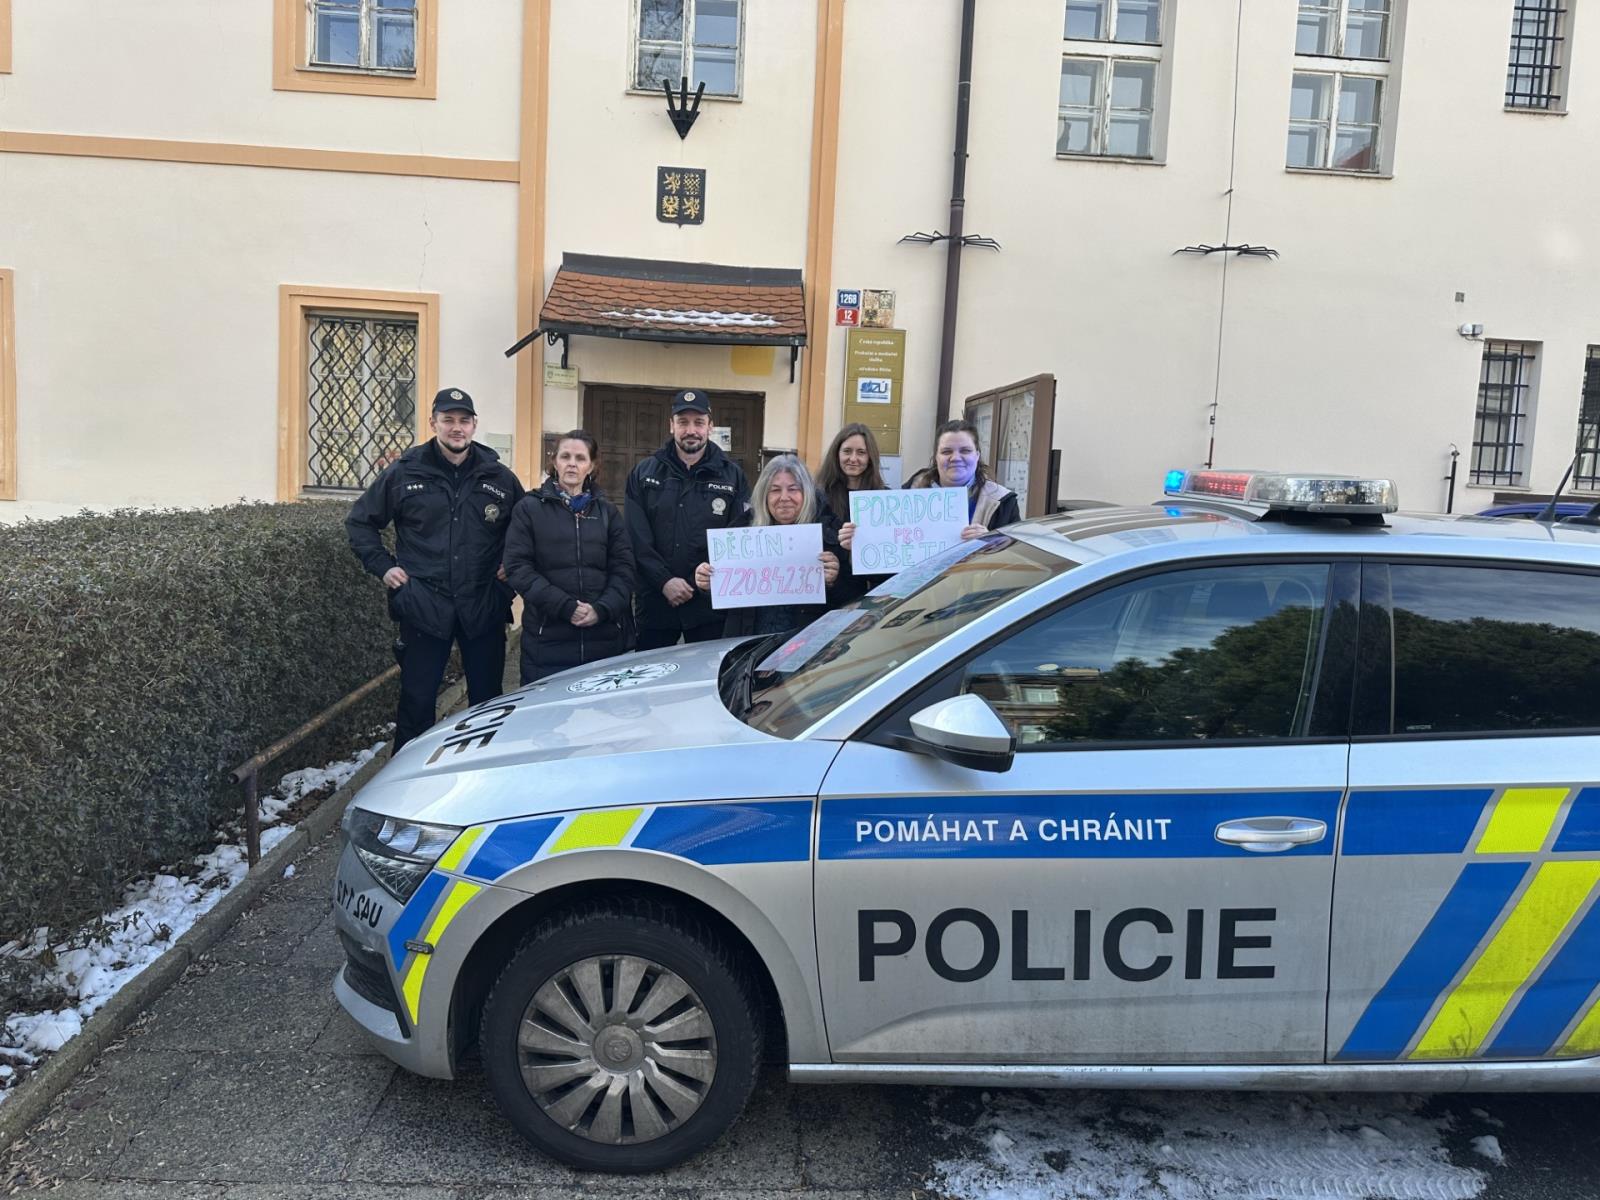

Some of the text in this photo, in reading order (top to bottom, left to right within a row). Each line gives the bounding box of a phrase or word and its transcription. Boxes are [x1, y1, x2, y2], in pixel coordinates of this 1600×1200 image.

[840, 293, 857, 304] 1268
[844, 310, 853, 320] 12
[482, 483, 506, 499] POLICIE
[708, 483, 734, 492] POLICIE
[853, 491, 961, 527] PORADCE
[893, 527, 924, 544] PRO
[856, 812, 1172, 843] POMÁHAT A CHRÁNIT
[857, 907, 1277, 982] POLICIE
